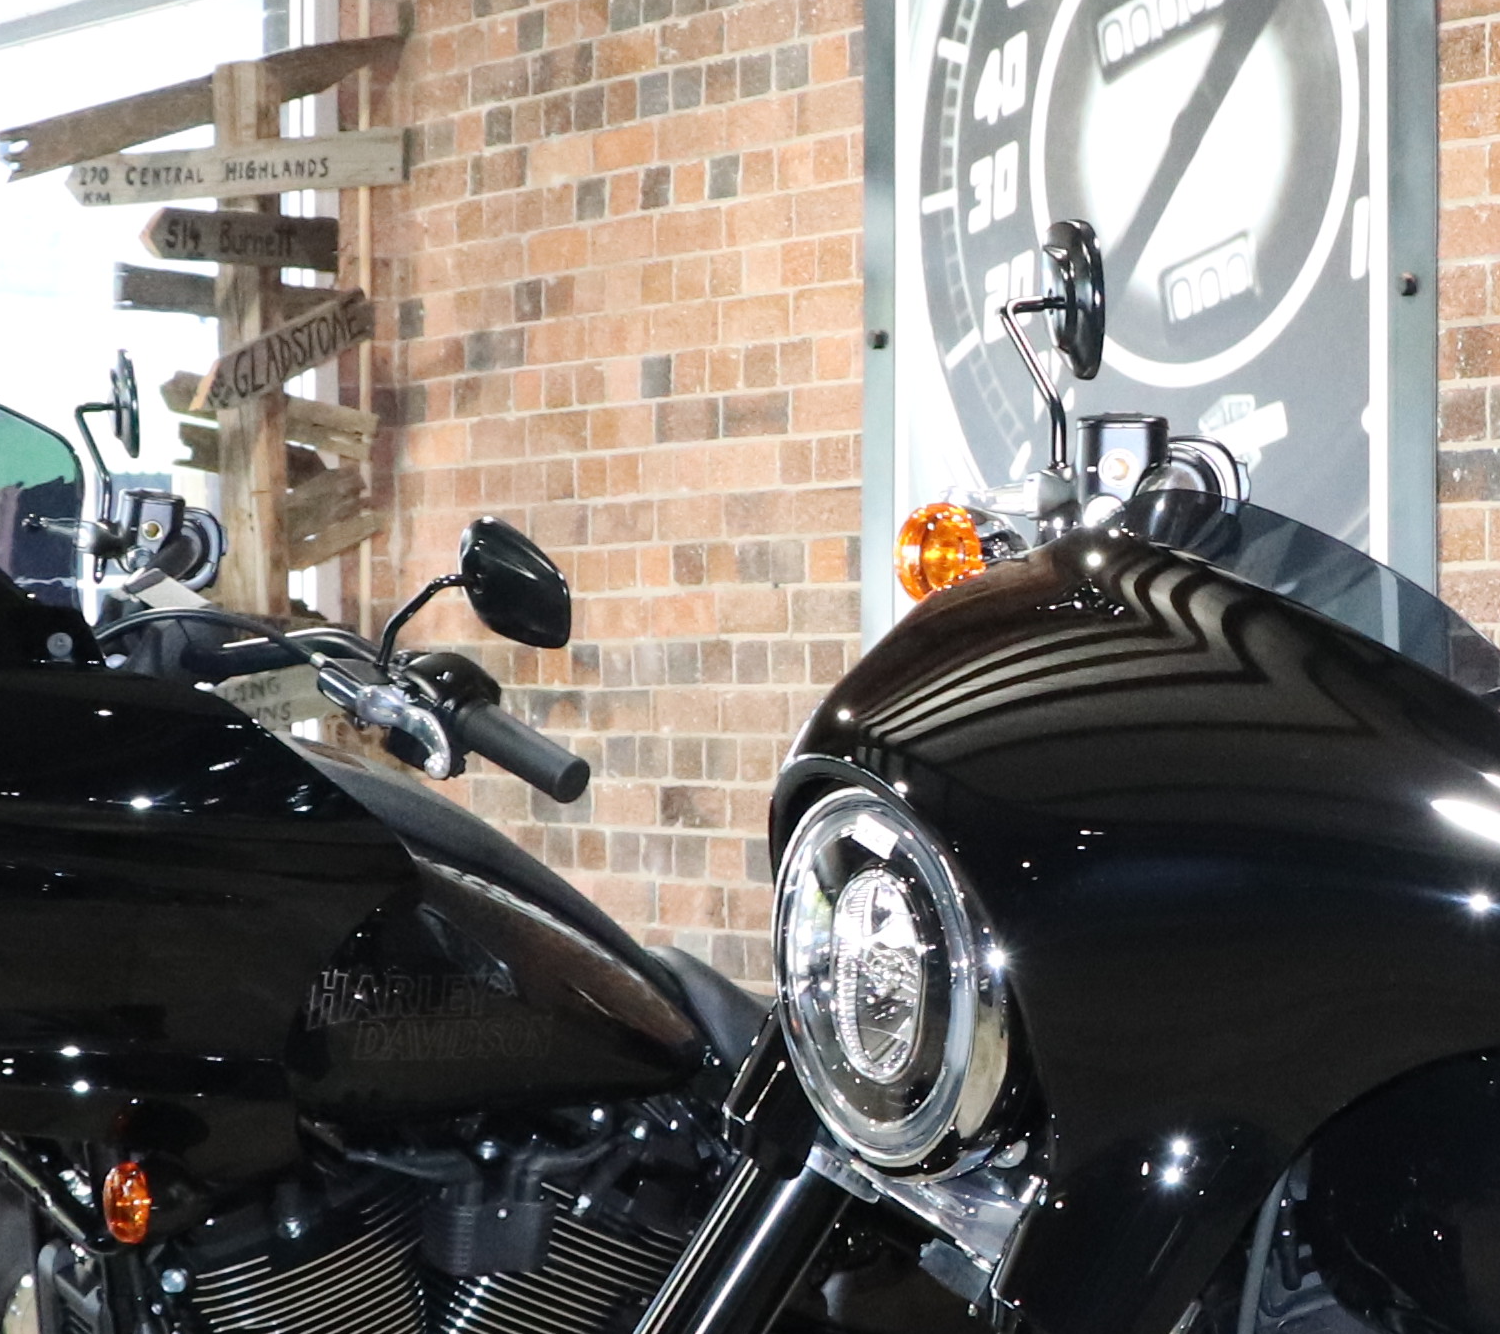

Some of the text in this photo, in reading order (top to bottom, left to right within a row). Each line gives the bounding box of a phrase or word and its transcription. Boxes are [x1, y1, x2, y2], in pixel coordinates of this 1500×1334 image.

[974, 30, 1028, 125] 40
[124, 165, 205, 187] CENTRAL
[224, 157, 330, 182] HIGHLANDS
[968, 140, 1019, 234] 30
[219, 218, 298, 257] Burnett
[234, 307, 368, 399] GLADSTONE
